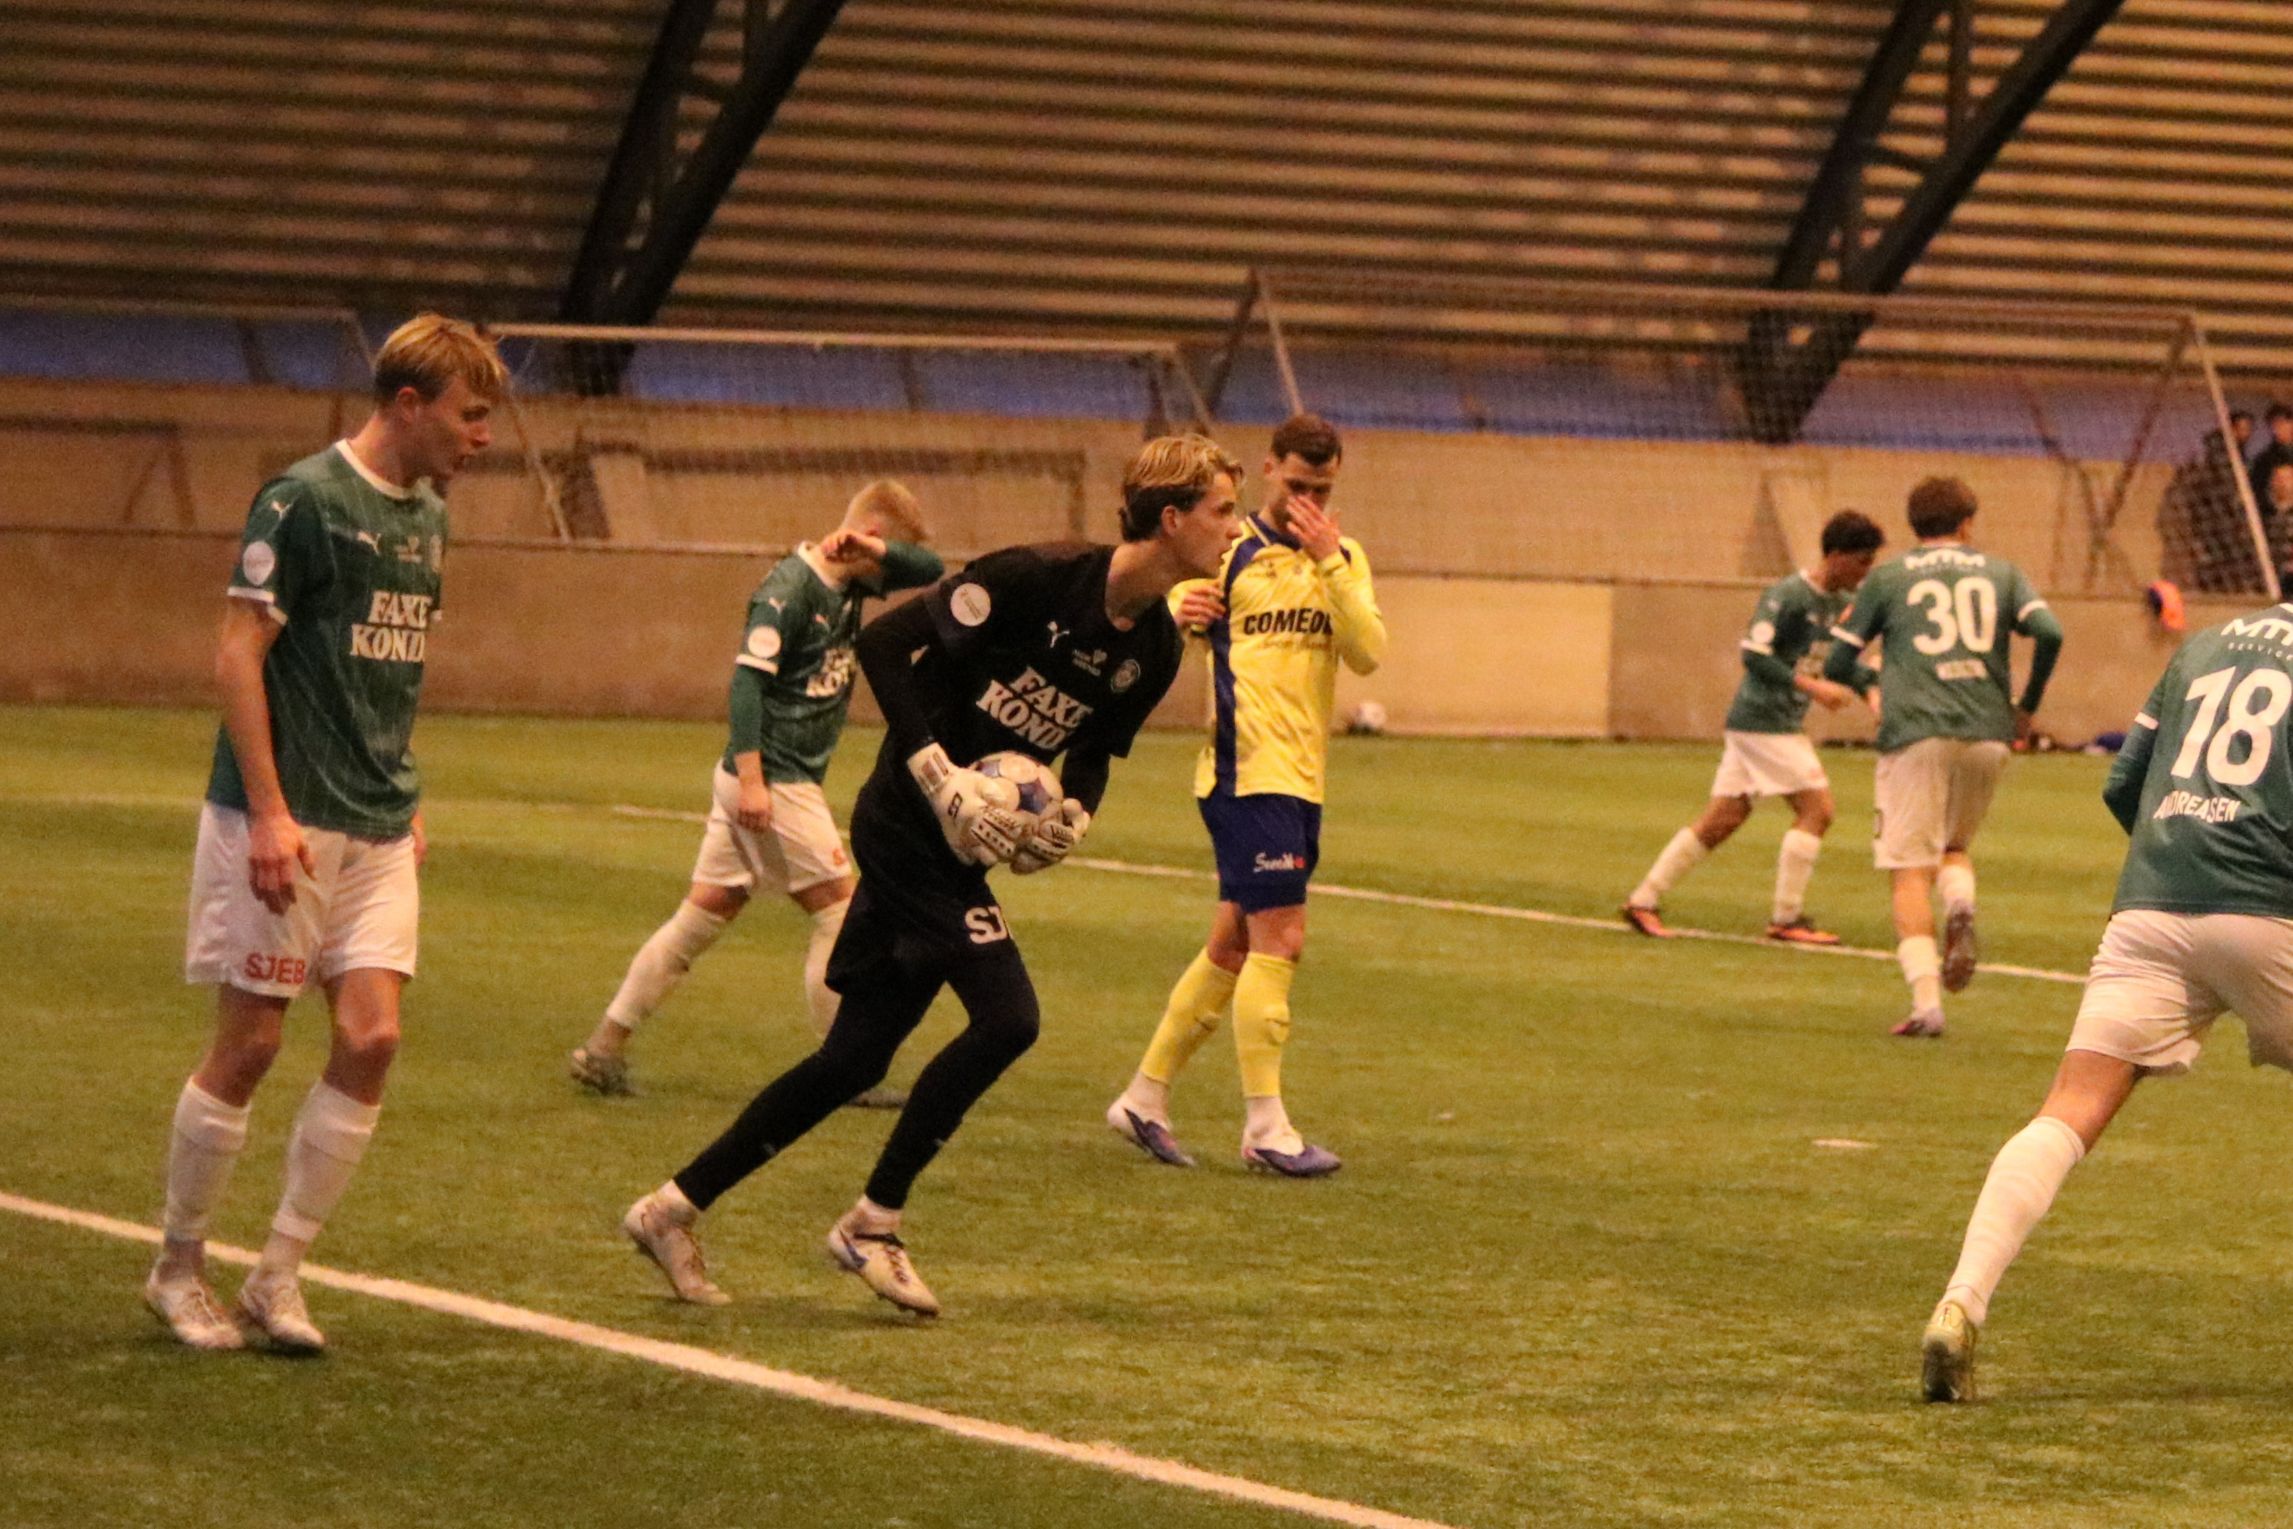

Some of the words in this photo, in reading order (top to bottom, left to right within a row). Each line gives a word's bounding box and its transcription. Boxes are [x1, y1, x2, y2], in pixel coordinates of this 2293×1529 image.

[367, 590, 433, 629] FAXE
[1906, 576, 1998, 655] 30
[976, 679, 1072, 750] KOND
[1008, 665, 1094, 728] FAXE
[2170, 666, 2293, 786] 18
